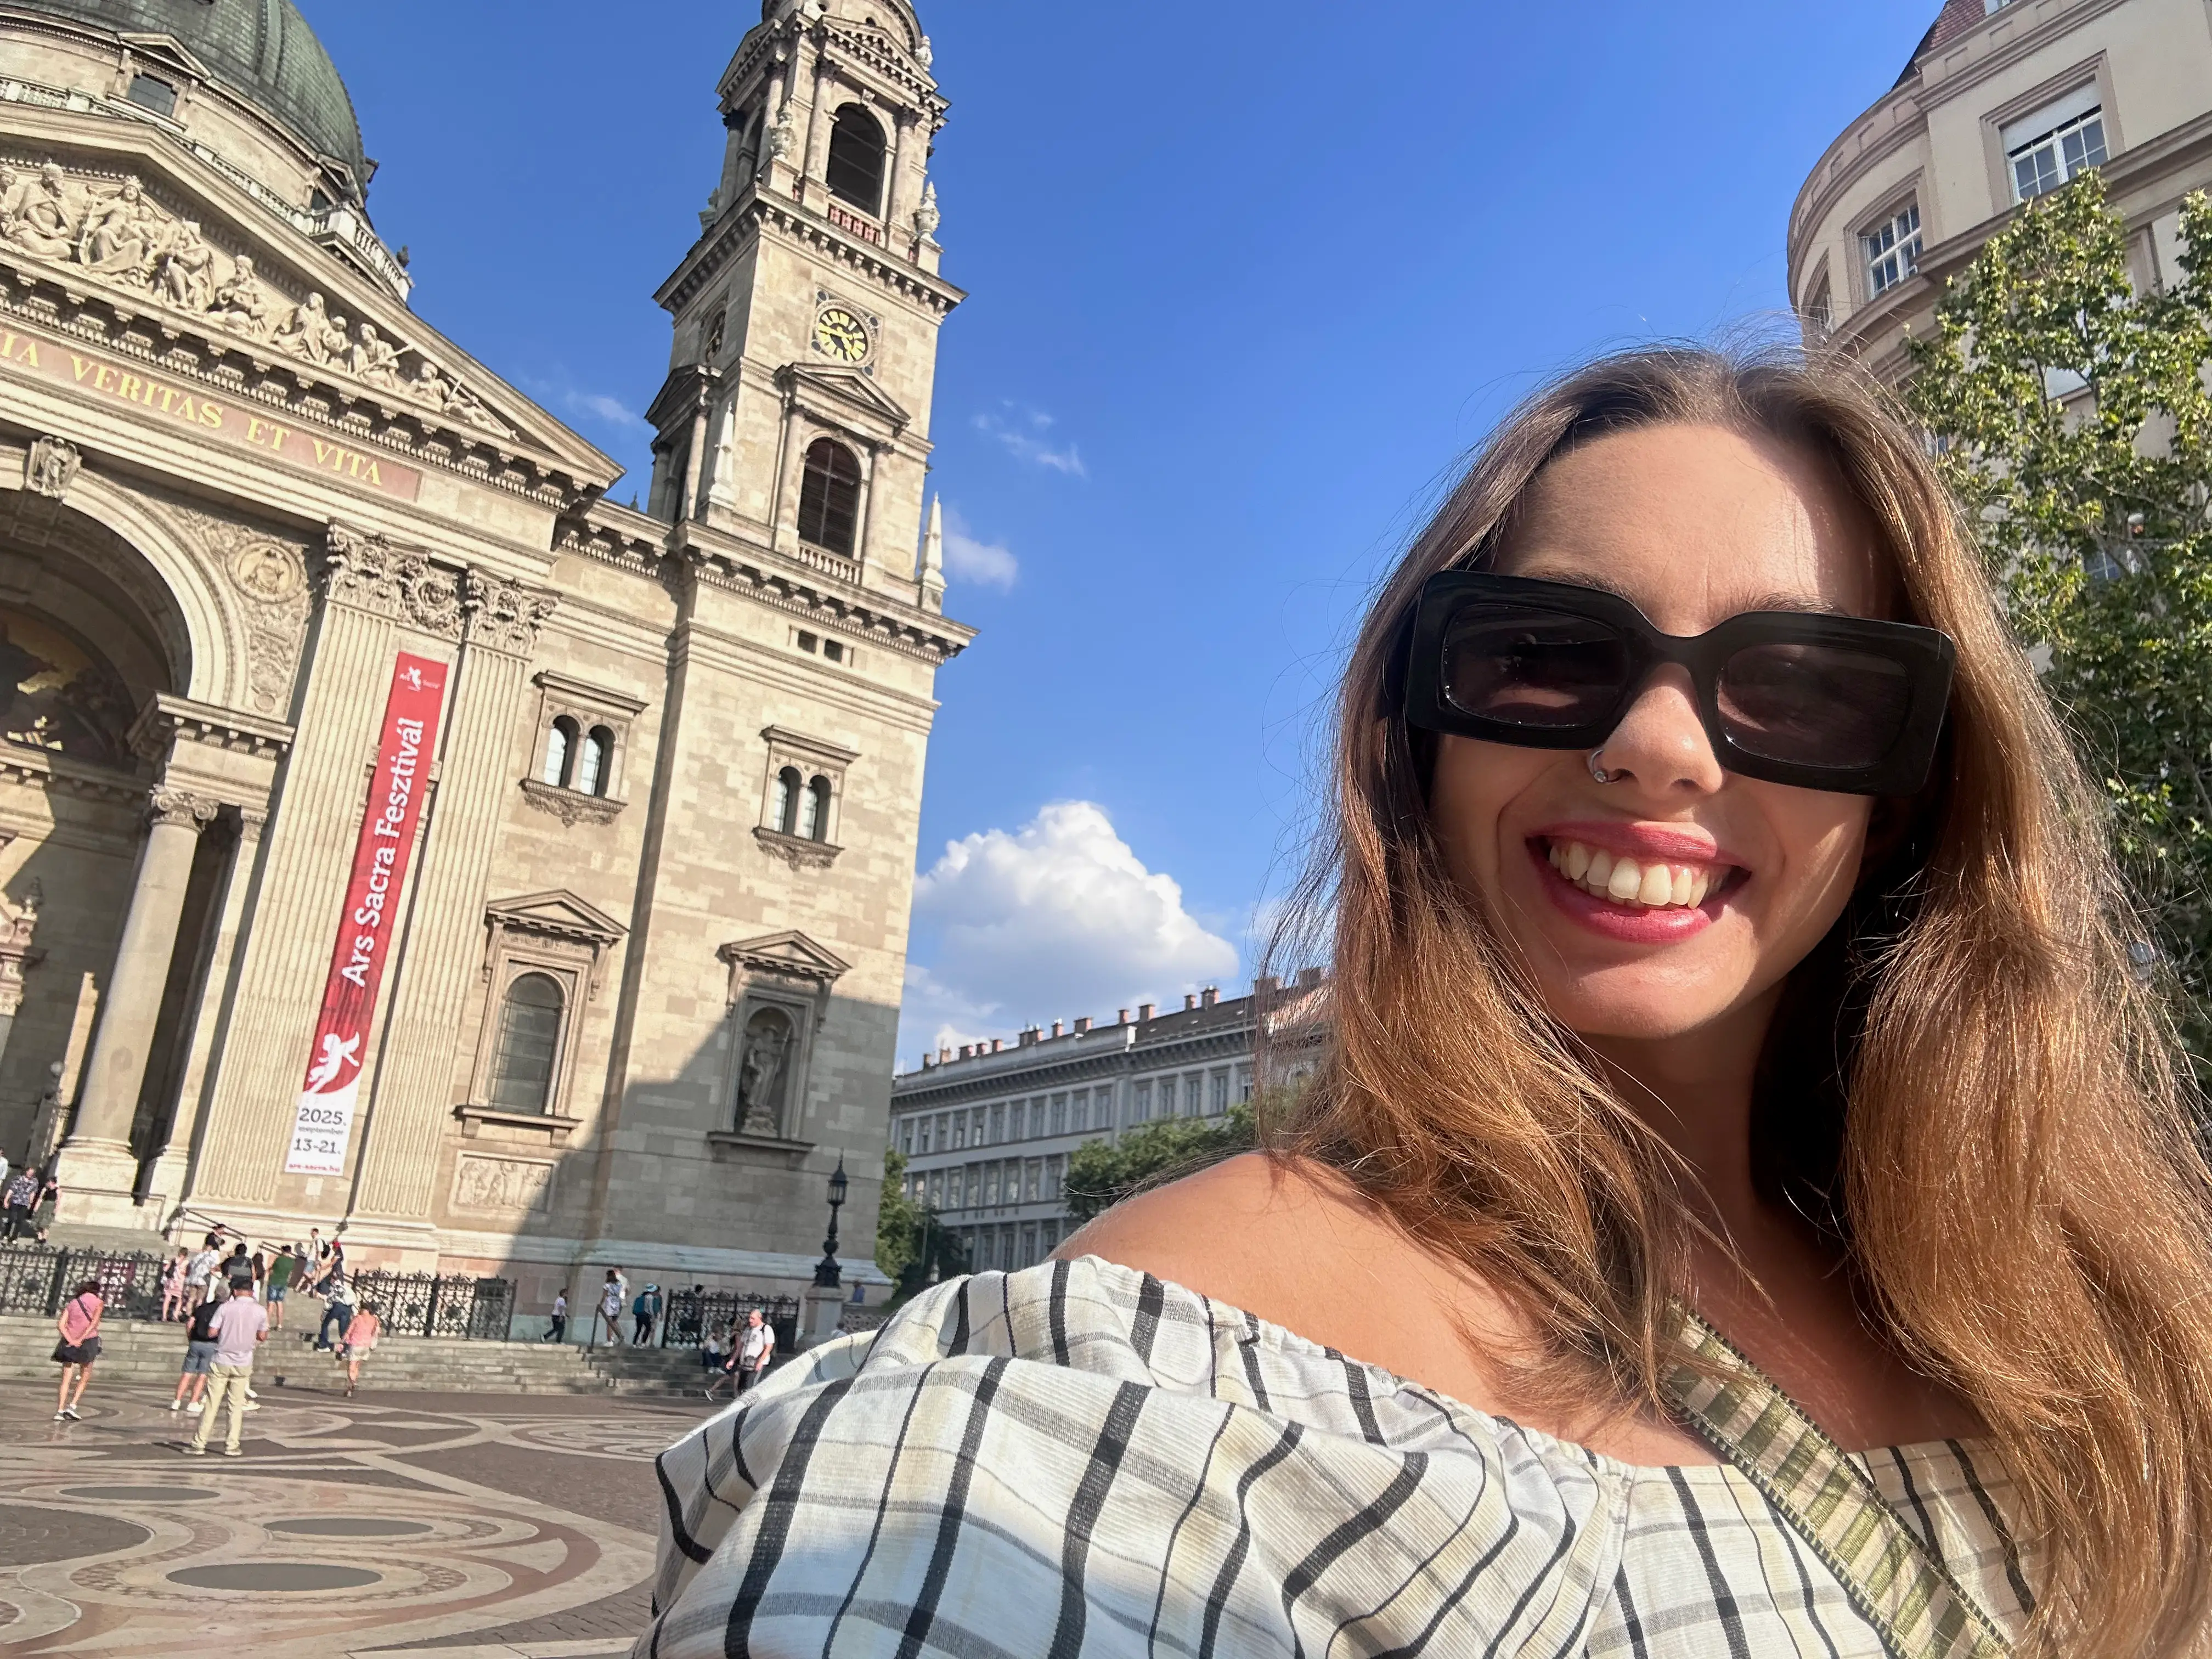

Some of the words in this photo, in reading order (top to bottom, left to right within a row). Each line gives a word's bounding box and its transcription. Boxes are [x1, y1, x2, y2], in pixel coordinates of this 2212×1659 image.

[70, 354, 223, 428] VERITAS
[247, 417, 291, 452] ET
[312, 439, 382, 486] VITA
[374, 716, 424, 838] Fesztivál
[354, 847, 396, 928] Sacra
[341, 932, 375, 988] Ars
[294, 1138, 341, 1155] 13-21.
[299, 1107, 347, 1126] 2025.
